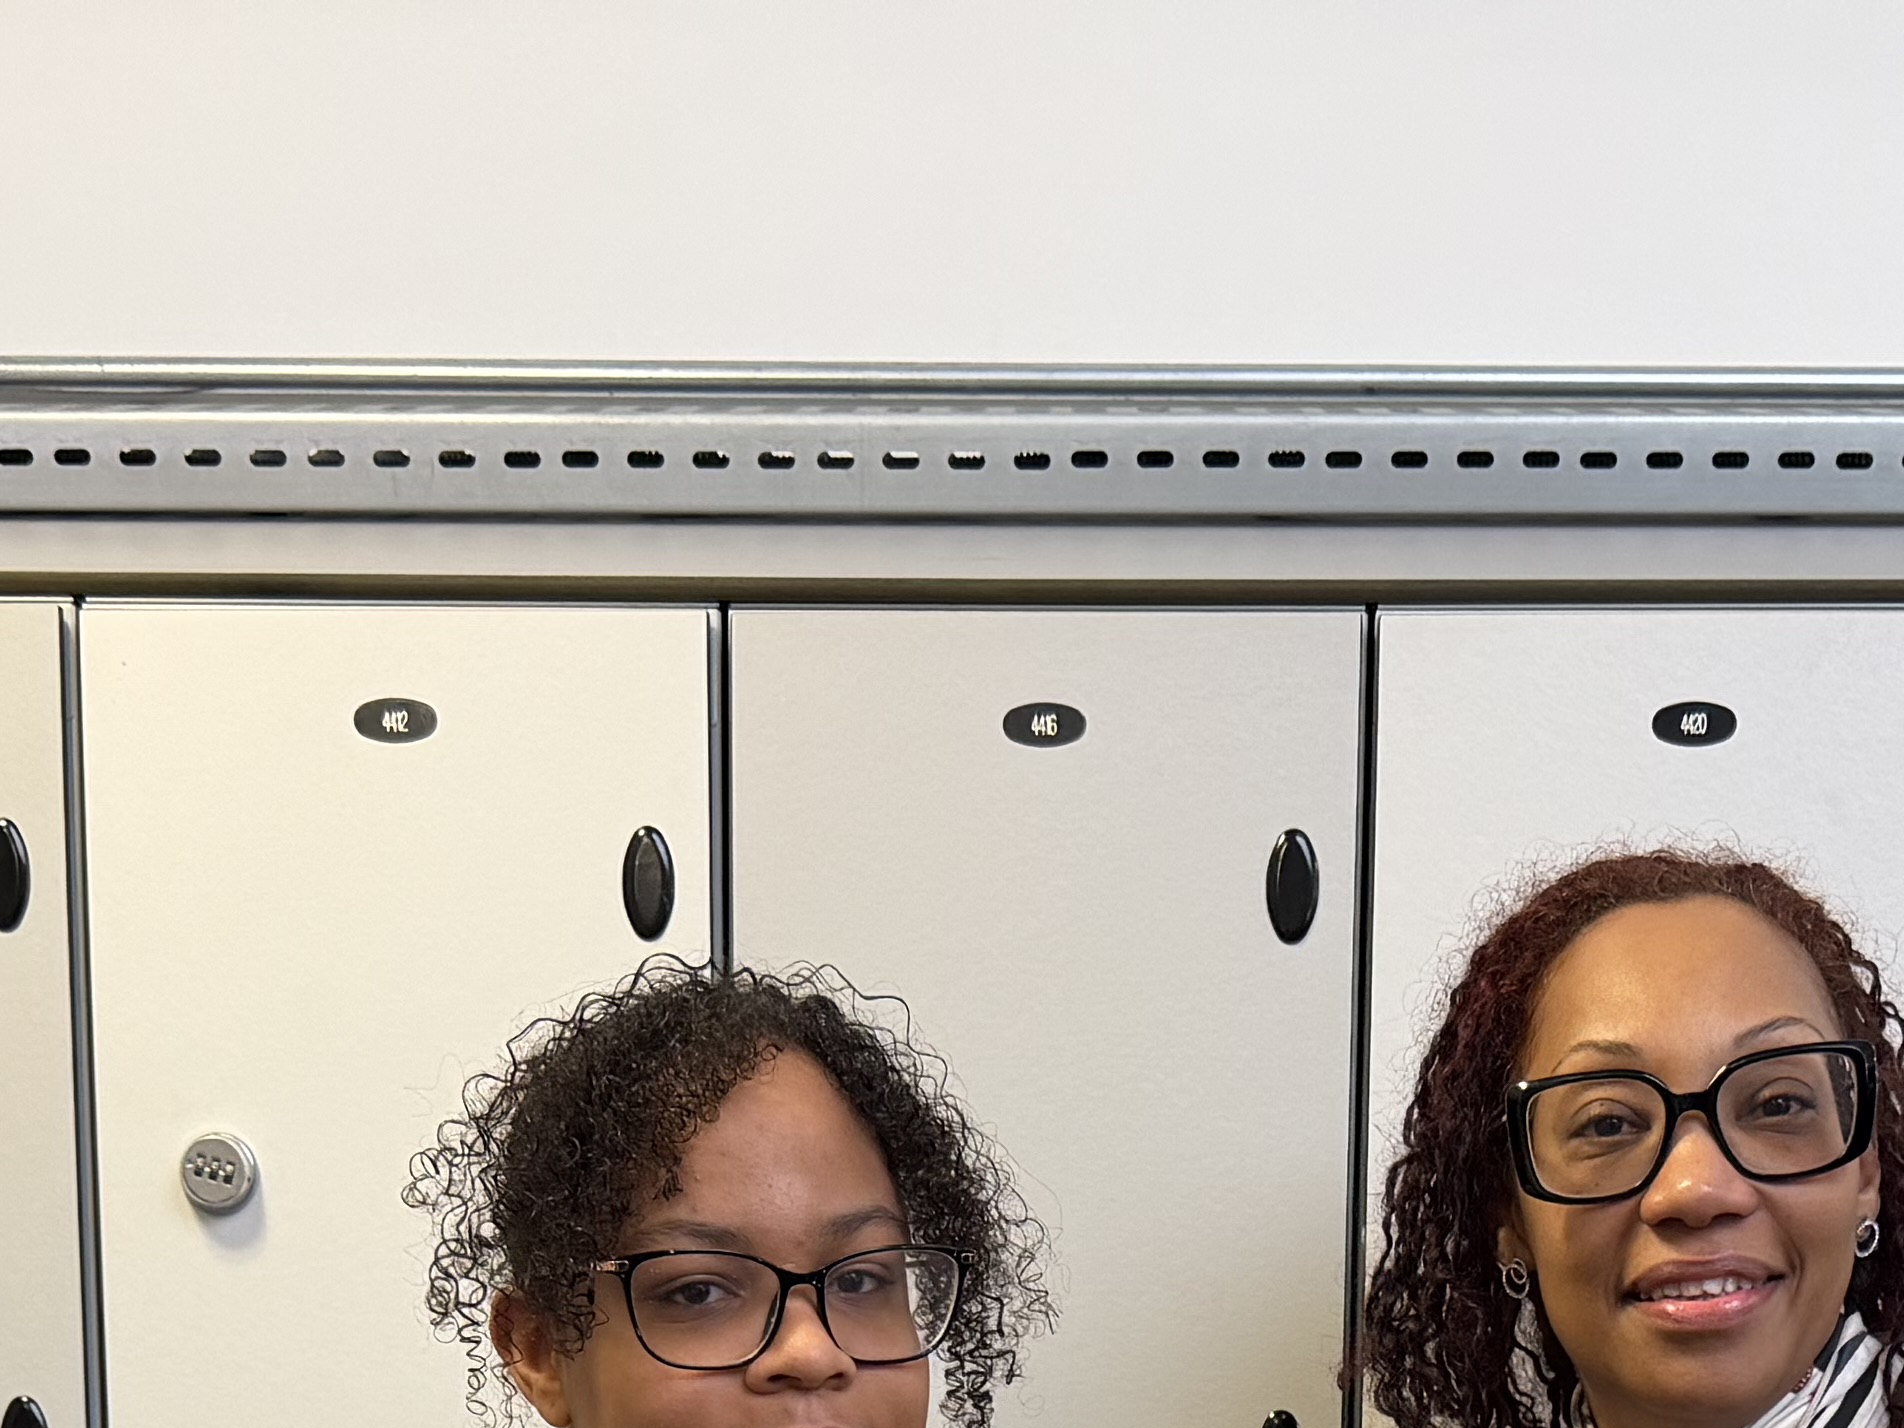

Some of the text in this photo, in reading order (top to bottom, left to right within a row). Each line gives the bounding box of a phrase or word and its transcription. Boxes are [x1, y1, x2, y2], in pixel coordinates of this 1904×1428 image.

[381, 709, 409, 733] 4412
[1031, 713, 1058, 736] 4416
[1680, 712, 1708, 735] 4420
